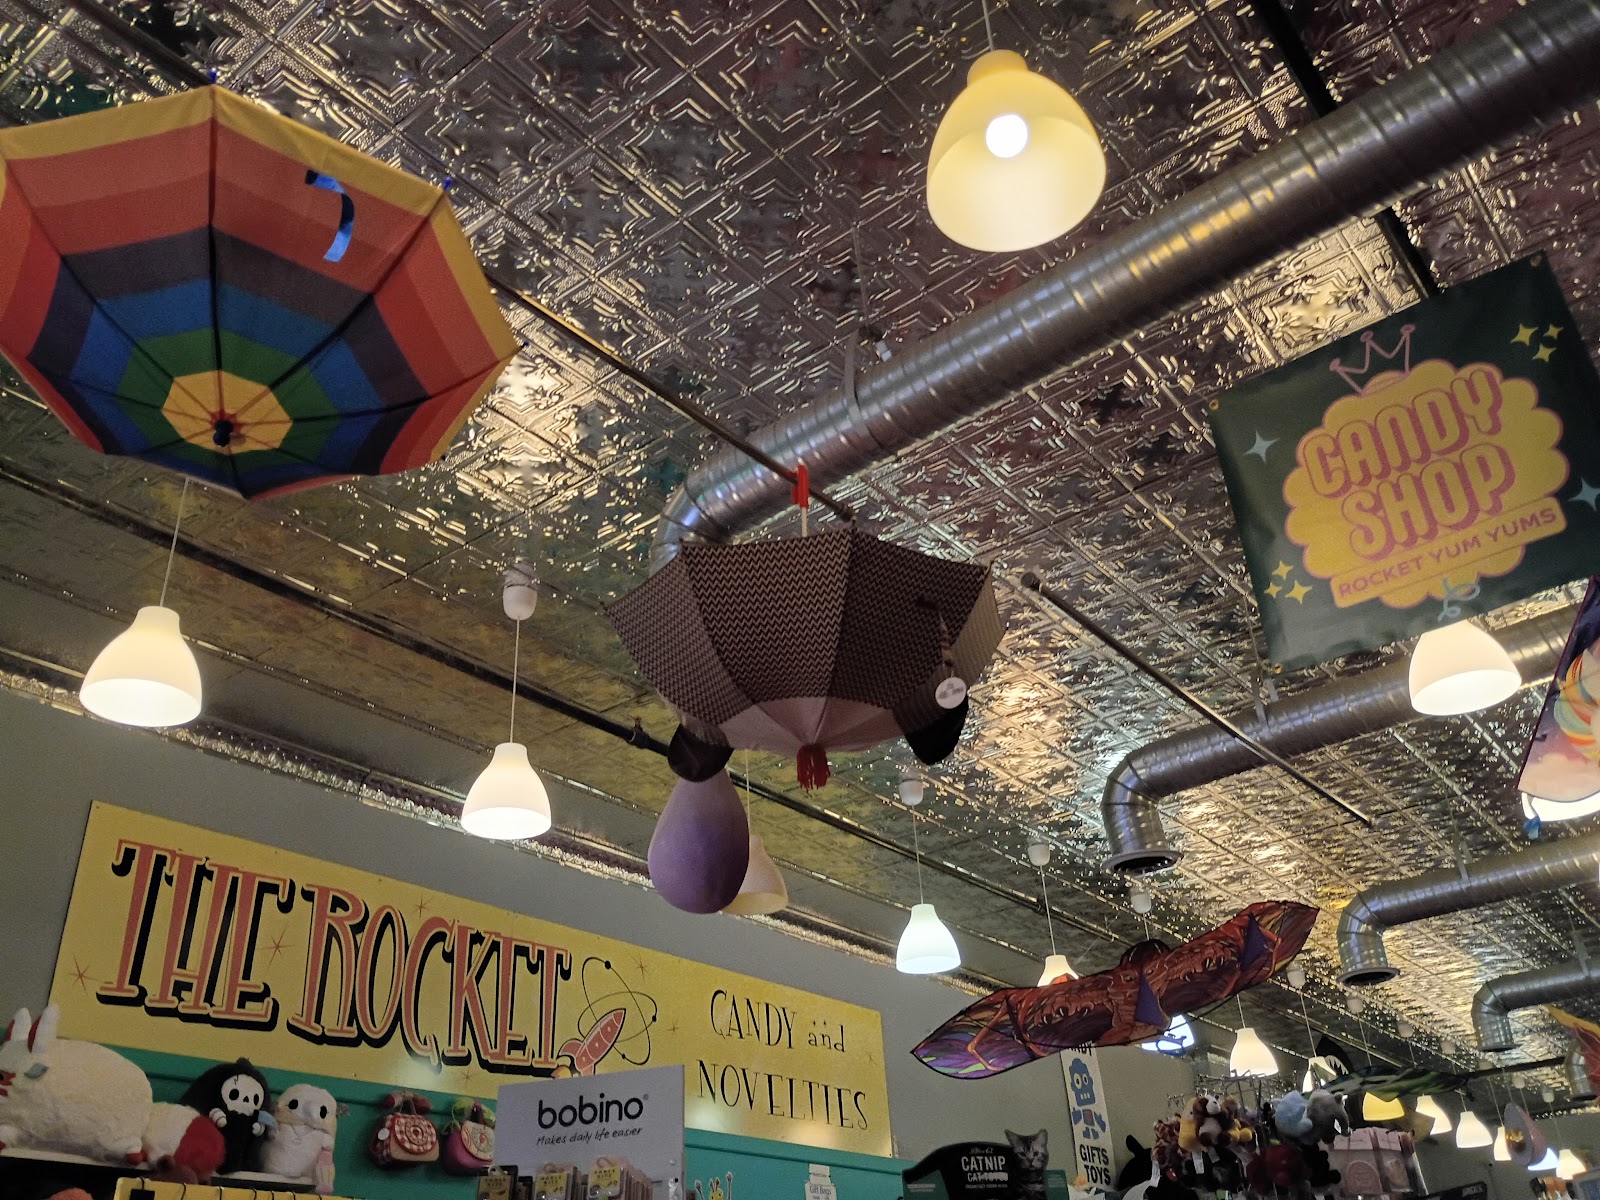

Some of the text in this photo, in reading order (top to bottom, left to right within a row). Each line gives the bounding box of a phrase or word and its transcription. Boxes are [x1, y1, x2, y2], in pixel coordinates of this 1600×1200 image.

[1303, 370, 1503, 498] CANDY
[1342, 443, 1516, 562] SHOP
[1338, 507, 1558, 598] ROCKET YUM YUMS
[96, 838, 572, 1078] THE ROCKET
[710, 988, 846, 1053] CANDY and
[537, 1092, 645, 1130] bobino
[696, 1059, 868, 1131] NOVELTIES
[536, 1126, 643, 1146] Makes daily life easier
[961, 1155, 1006, 1172] CATNIP
[1079, 1143, 1110, 1166] GIFTS
[1083, 1163, 1112, 1186] TOYS
